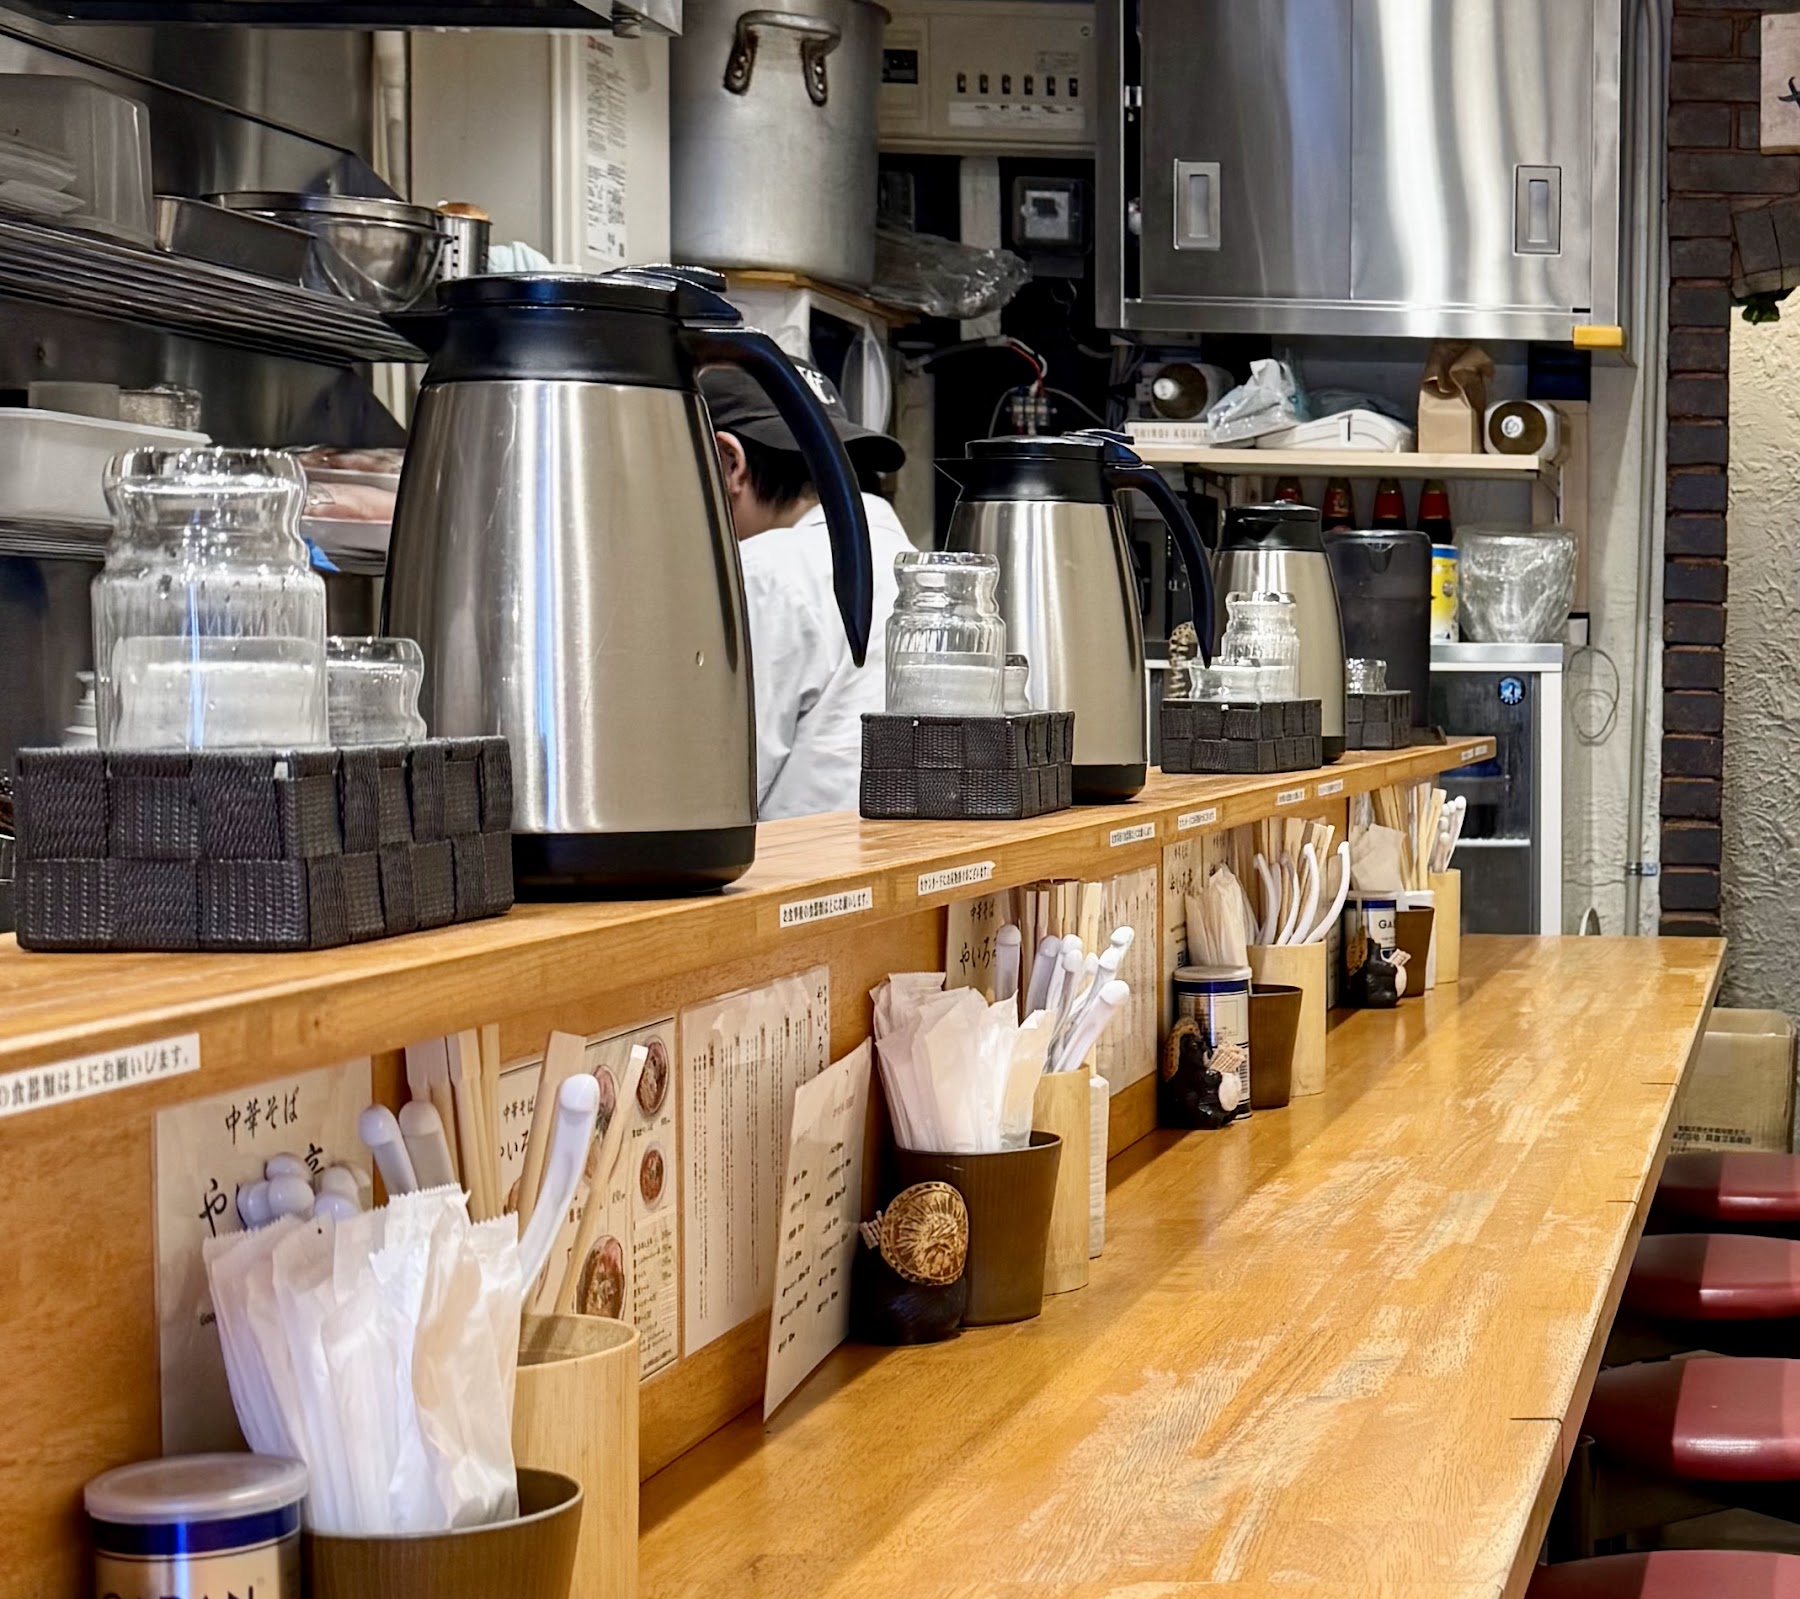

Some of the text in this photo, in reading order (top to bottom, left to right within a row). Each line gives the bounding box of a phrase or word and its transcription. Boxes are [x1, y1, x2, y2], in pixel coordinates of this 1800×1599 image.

[960, 937, 997, 976] やいろ
[225, 1086, 299, 1145] 中華そば
